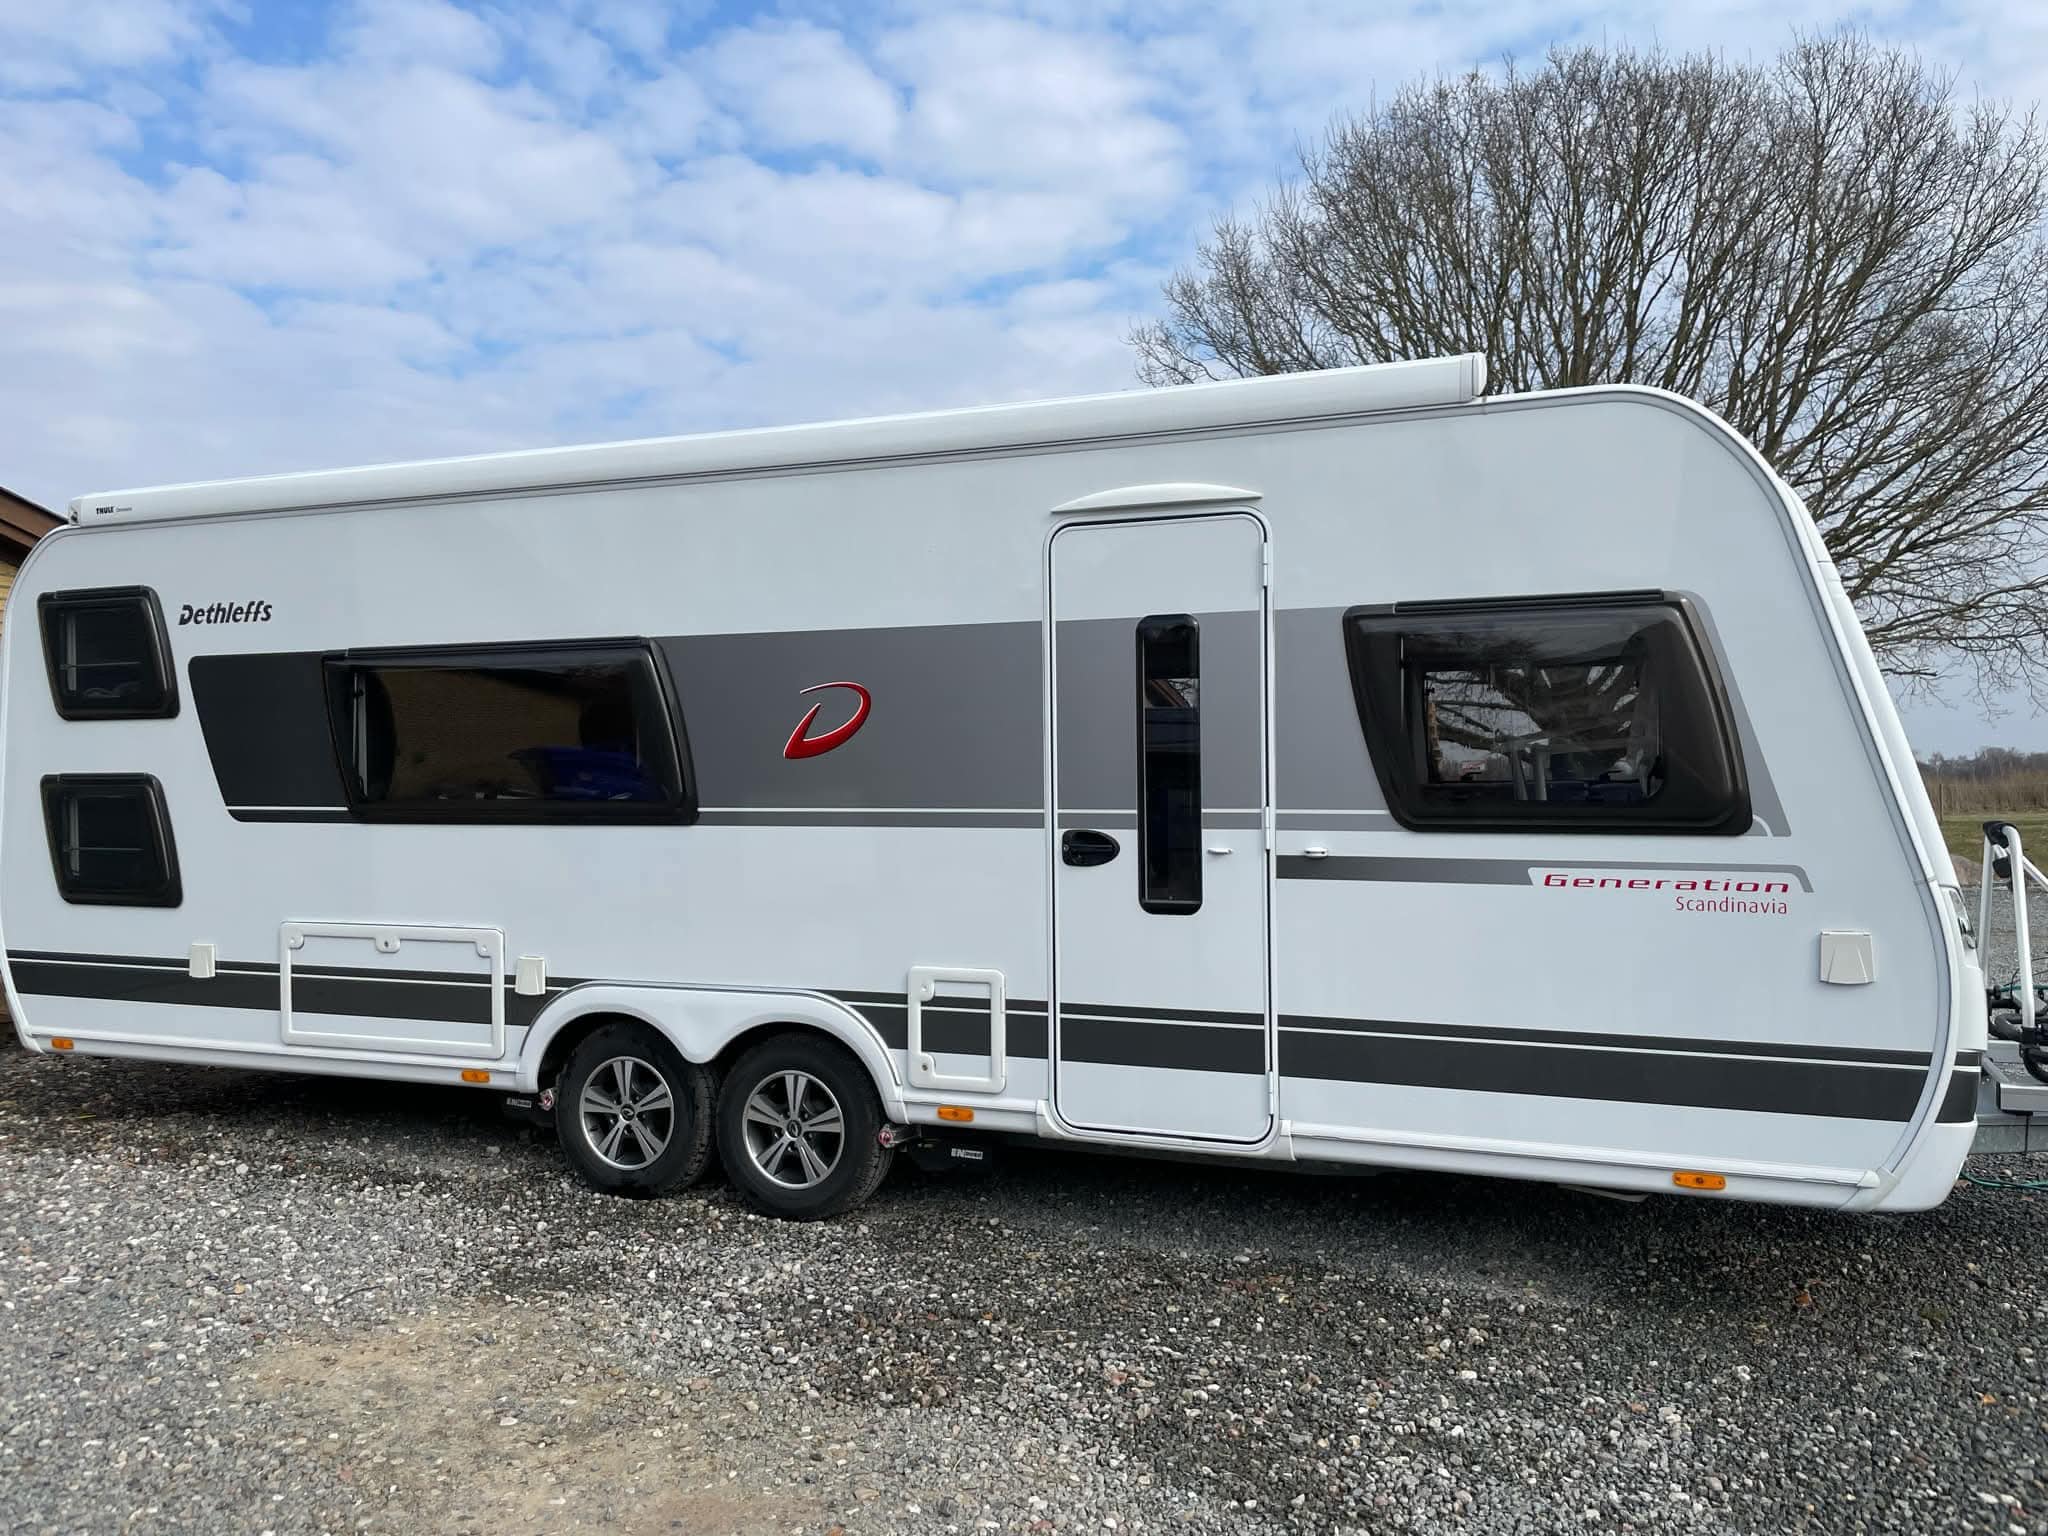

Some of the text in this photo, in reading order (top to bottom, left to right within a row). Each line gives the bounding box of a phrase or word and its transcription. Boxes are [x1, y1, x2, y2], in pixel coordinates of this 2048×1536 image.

[95, 506, 114, 515] THULE
[178, 600, 272, 625] Dethleffs
[1543, 874, 1789, 893] Generation
[1676, 896, 1788, 915] Scandinavia
